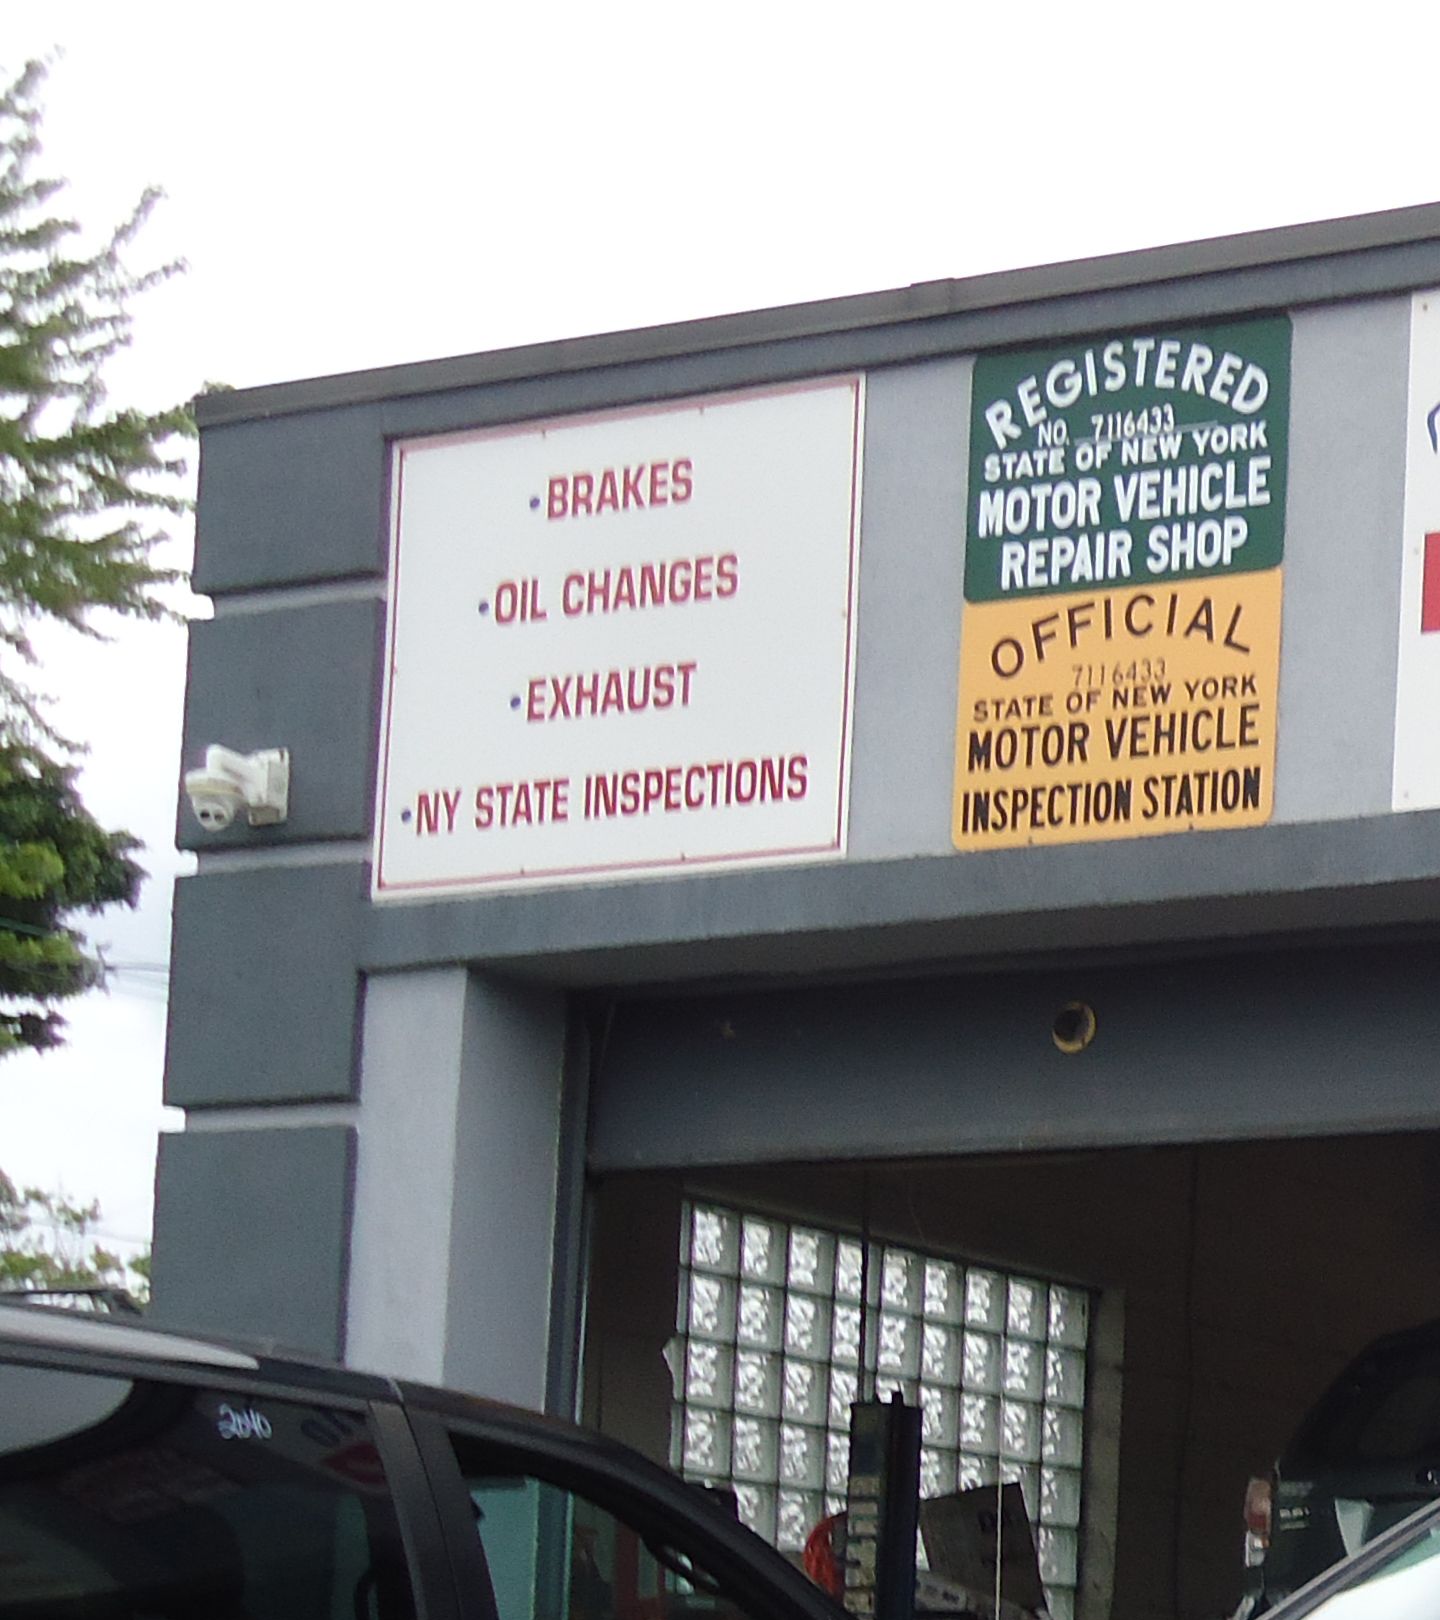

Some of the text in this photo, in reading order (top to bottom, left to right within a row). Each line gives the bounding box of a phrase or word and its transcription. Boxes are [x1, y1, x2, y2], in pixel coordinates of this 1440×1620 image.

[984, 337, 1270, 448] REGISTERED
[1037, 403, 1175, 447] NO. 7116433
[985, 420, 1267, 483] STATE OF NEW YORK
[547, 458, 693, 520] BRAKES
[978, 455, 1271, 539] MOTOR VEHICLE
[1001, 515, 1248, 591] REPAIR SHOP
[494, 553, 739, 625] OIL CHANGES
[990, 592, 1251, 679] OFFICIAL
[527, 662, 697, 723] EXHAUST
[973, 673, 1257, 723] STATE OF NEW YORK
[1072, 657, 1166, 688] 7116433
[967, 703, 1260, 773] MOTOR VEHICLE
[416, 754, 808, 835] NY STATE INSPECTIONS
[960, 765, 1262, 835] INSPECTION STATION
